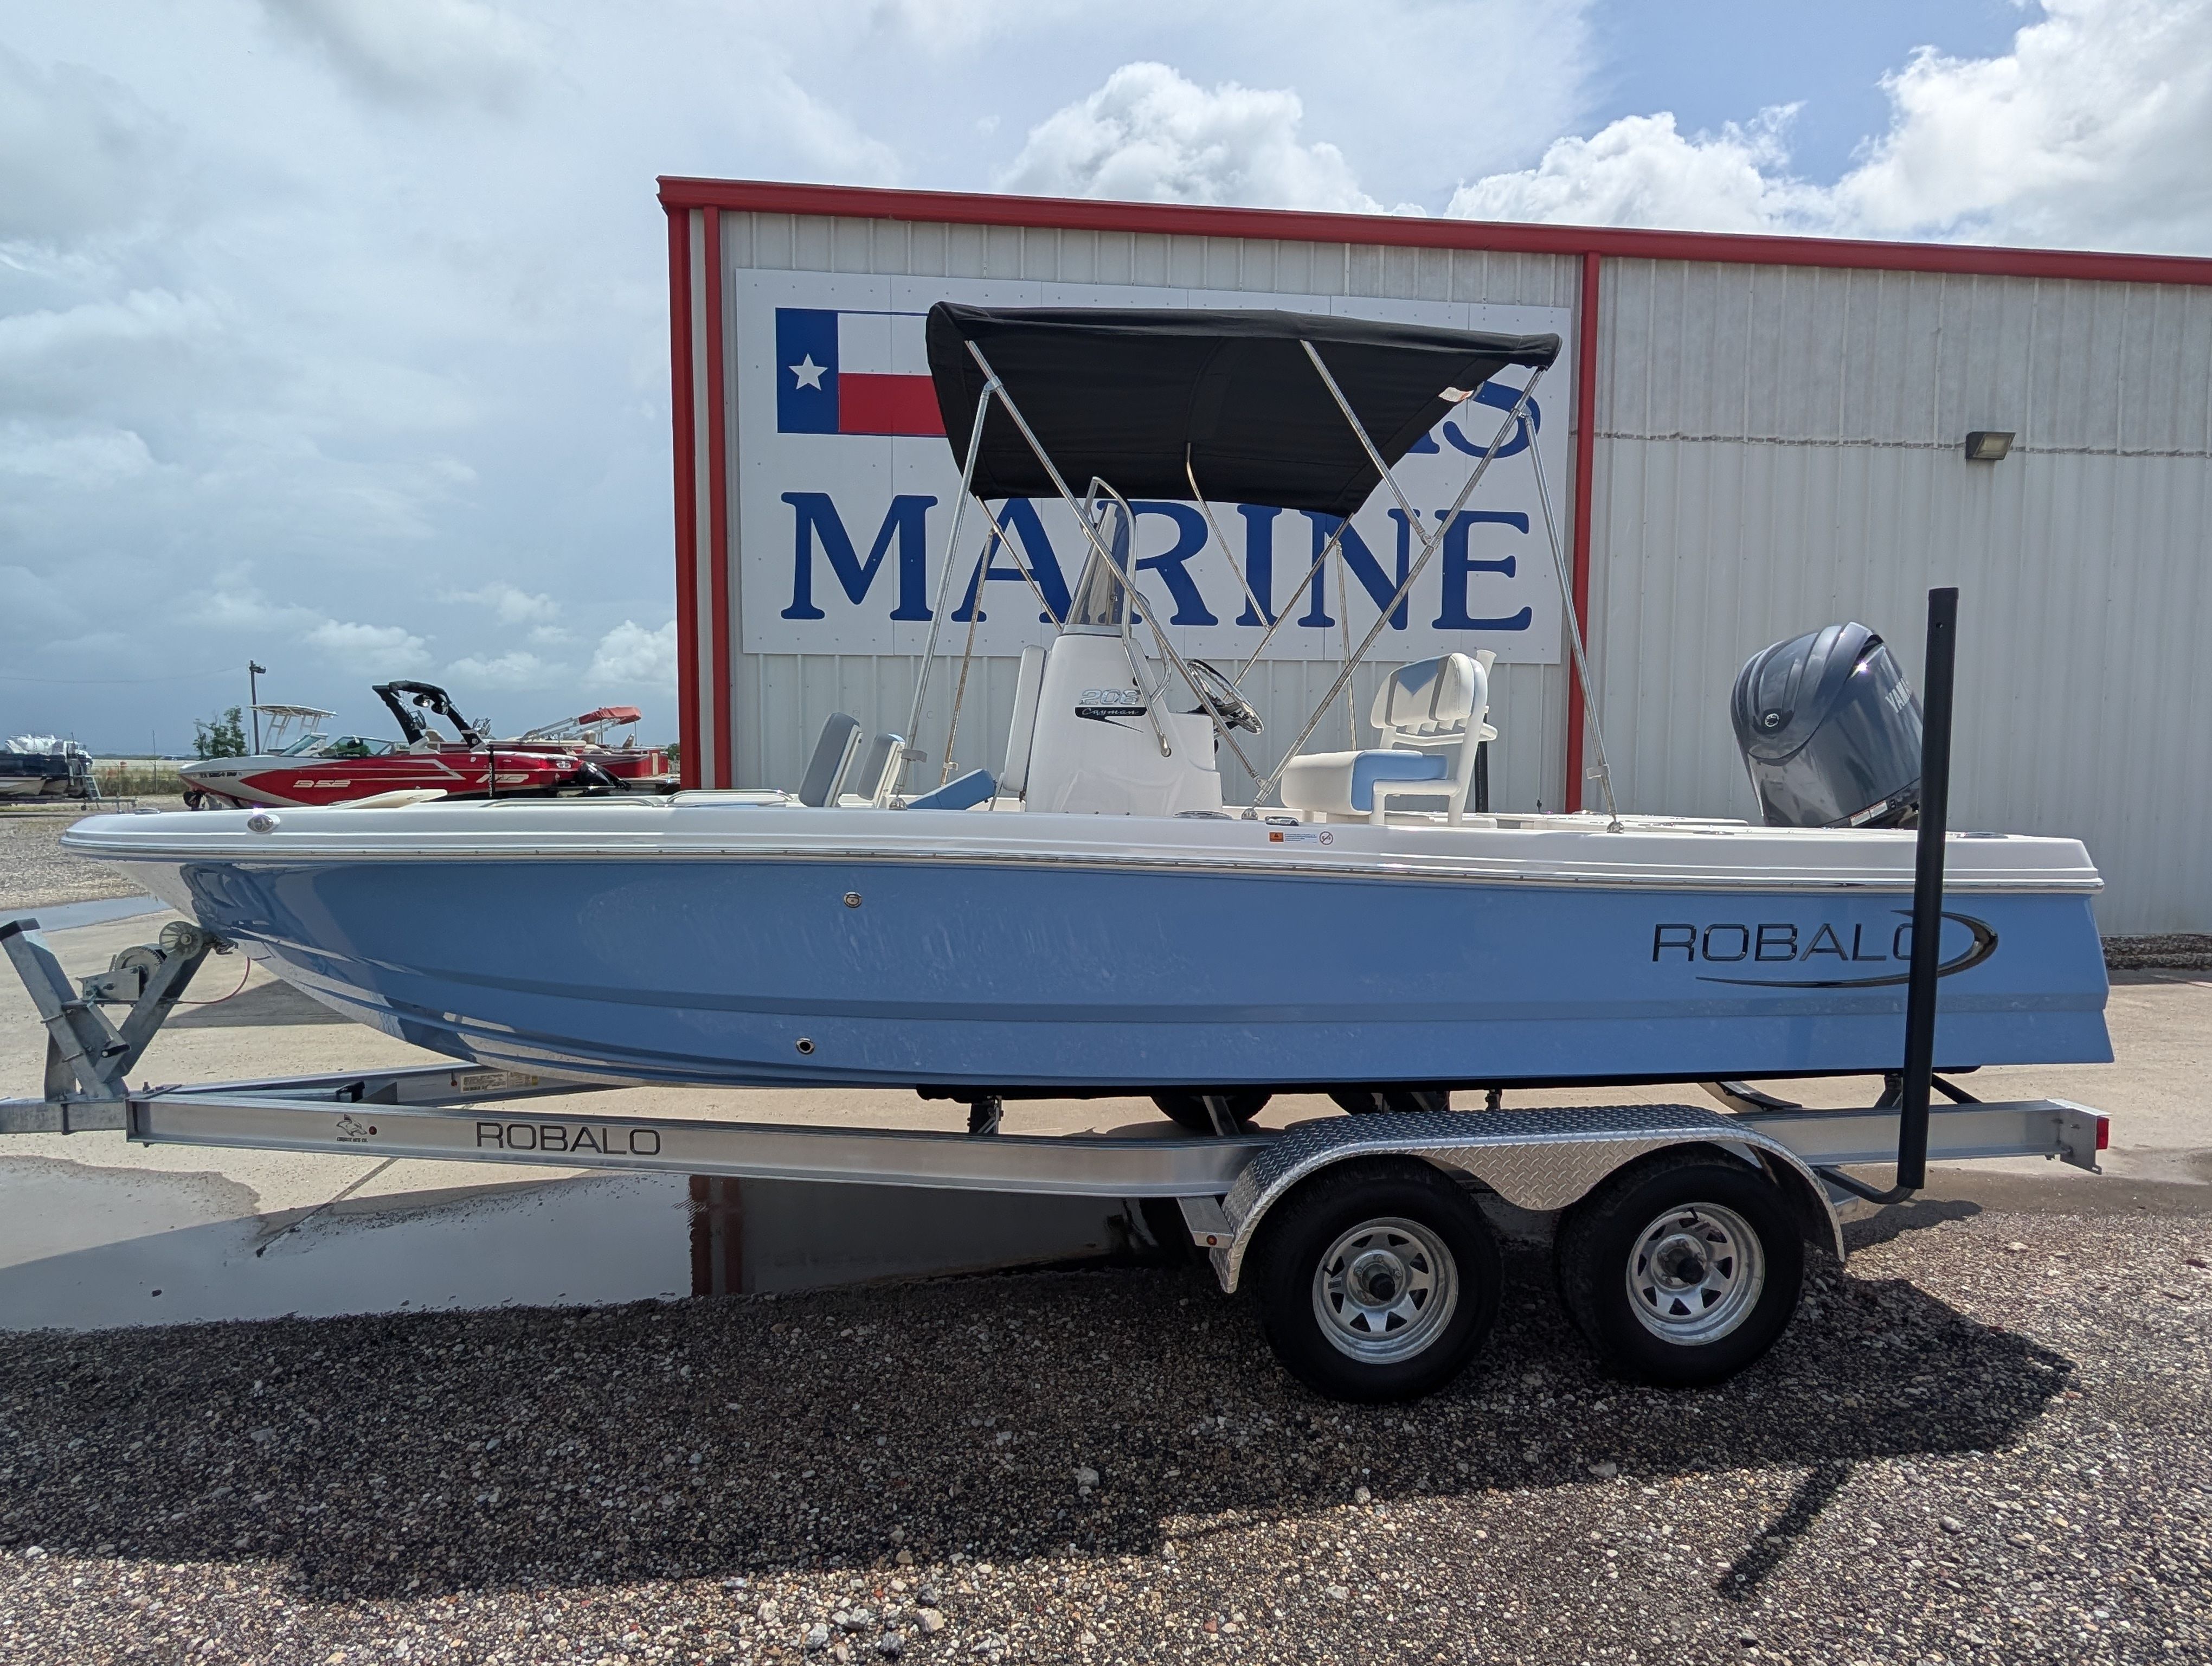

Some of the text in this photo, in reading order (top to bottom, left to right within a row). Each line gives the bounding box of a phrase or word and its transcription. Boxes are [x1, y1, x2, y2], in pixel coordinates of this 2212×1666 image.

[781, 492, 1533, 631] MARINE
[1079, 689, 1139, 705] 206
[1082, 707, 1139, 716] Cayman
[476, 1121, 661, 1156] ROBALO
